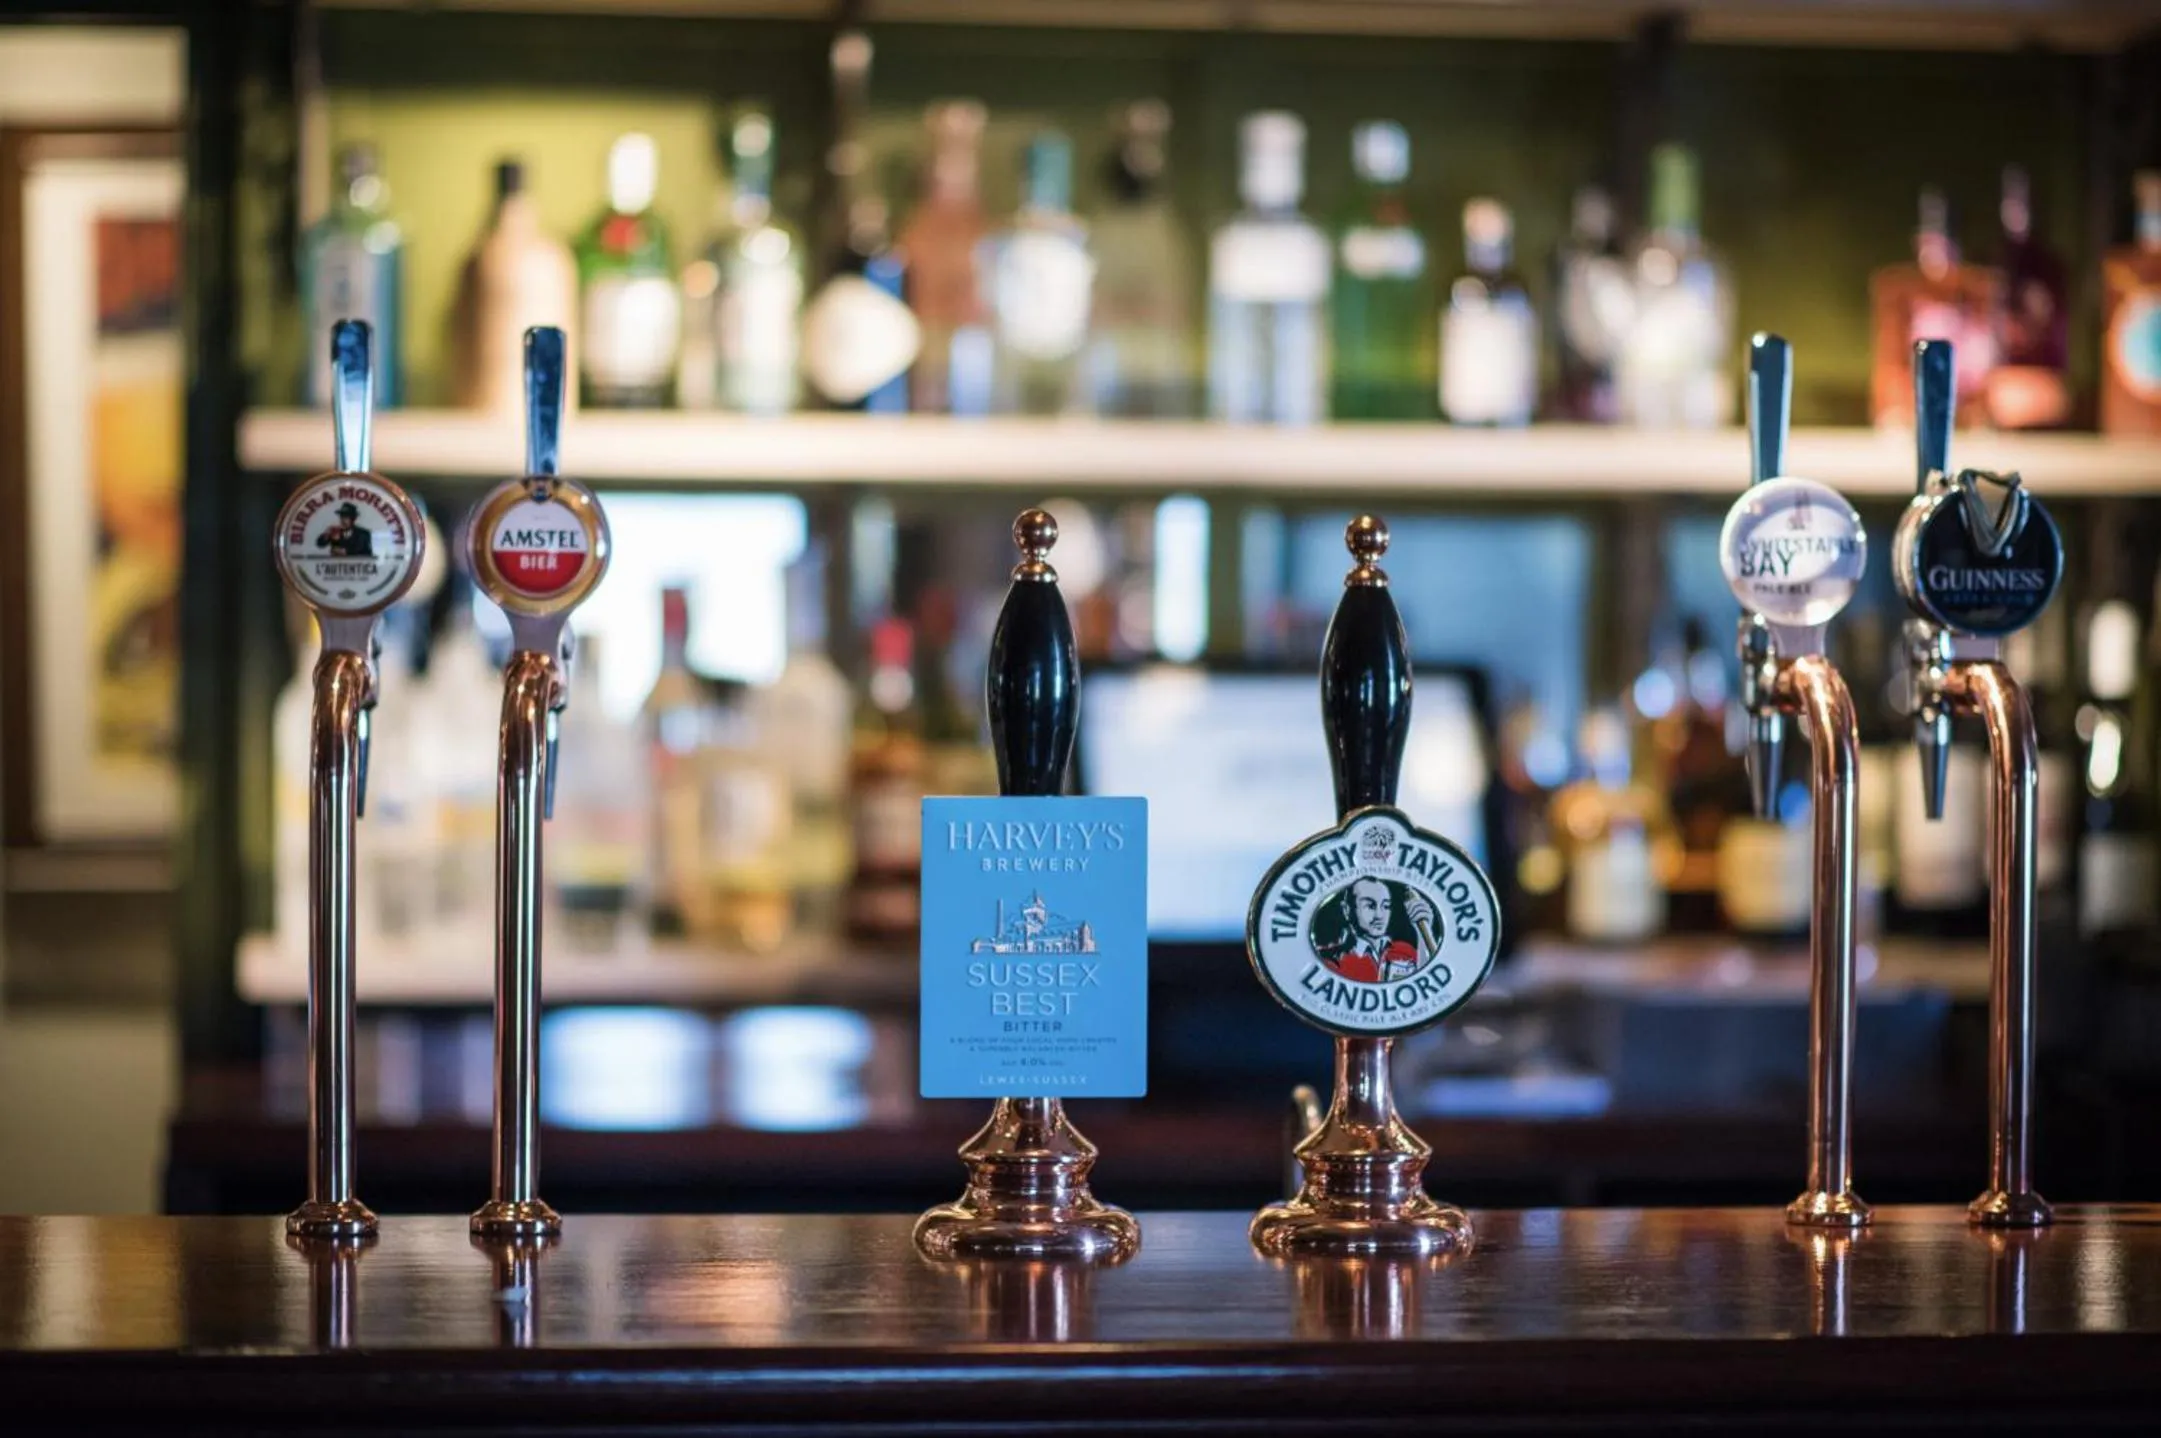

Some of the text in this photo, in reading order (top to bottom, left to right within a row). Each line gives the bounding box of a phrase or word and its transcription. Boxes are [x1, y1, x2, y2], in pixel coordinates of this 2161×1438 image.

[290, 485, 406, 546] BIRRA MORETTI
[500, 529, 580, 549] AMSTEL
[519, 554, 558, 570] BIER
[1740, 551, 1794, 577] BAY
[1928, 565, 2046, 591] GUINNESS
[947, 821, 1126, 851] HARVEY'S
[981, 857, 1090, 872] BREWERY
[1271, 842, 1485, 944] TIMOTHY TAYLOR'S
[966, 962, 1101, 988] SUSSEX
[1301, 963, 1453, 1012] LANDLORD
[990, 991, 1079, 1017] BEST
[1003, 1020, 1063, 1033] BITTER
